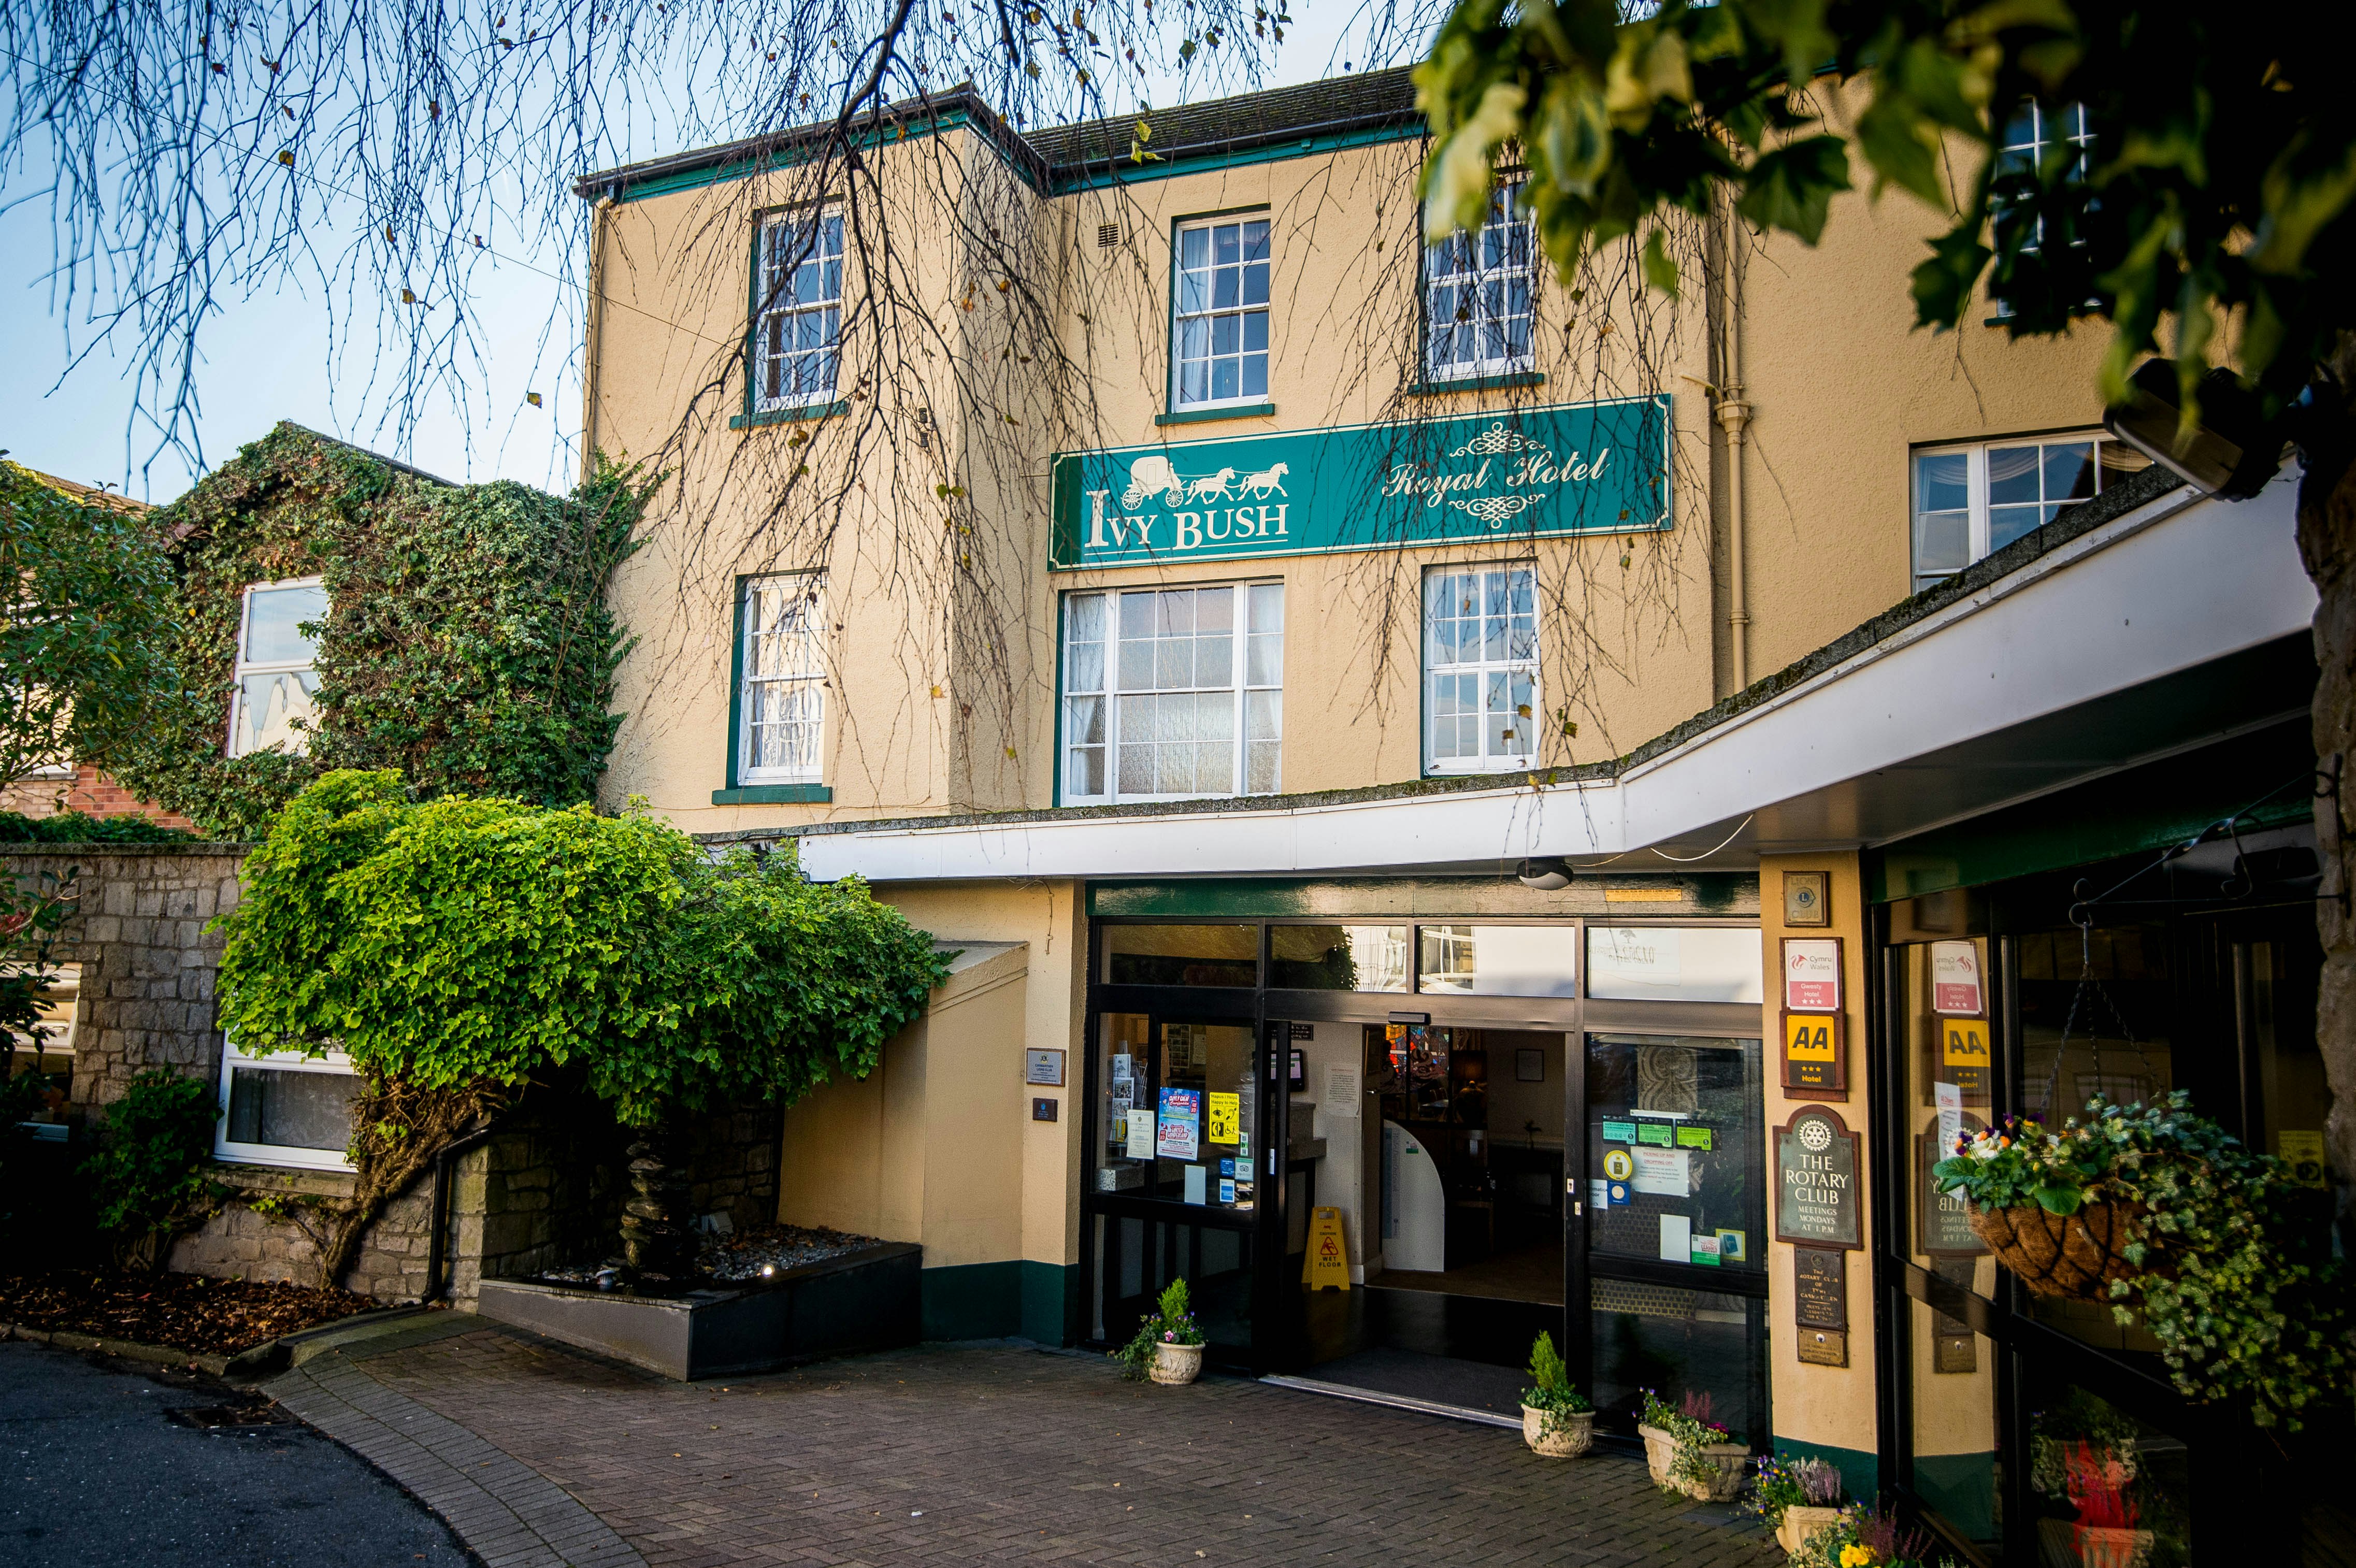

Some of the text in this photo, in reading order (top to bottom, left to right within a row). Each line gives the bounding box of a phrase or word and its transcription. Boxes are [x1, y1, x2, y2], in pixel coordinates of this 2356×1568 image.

[1382, 448, 1611, 508] Royal Hotel
[1172, 504, 1289, 550] BUSH
[1792, 1026, 1828, 1049] AA
[1800, 1154, 1833, 1171] THE
[1786, 1169, 1848, 1188] ROTARY
[1794, 1187, 1839, 1204] CLUB
[1798, 1205, 1837, 1215] MEETINGS
[1799, 1214, 1835, 1224] MONDAYS
